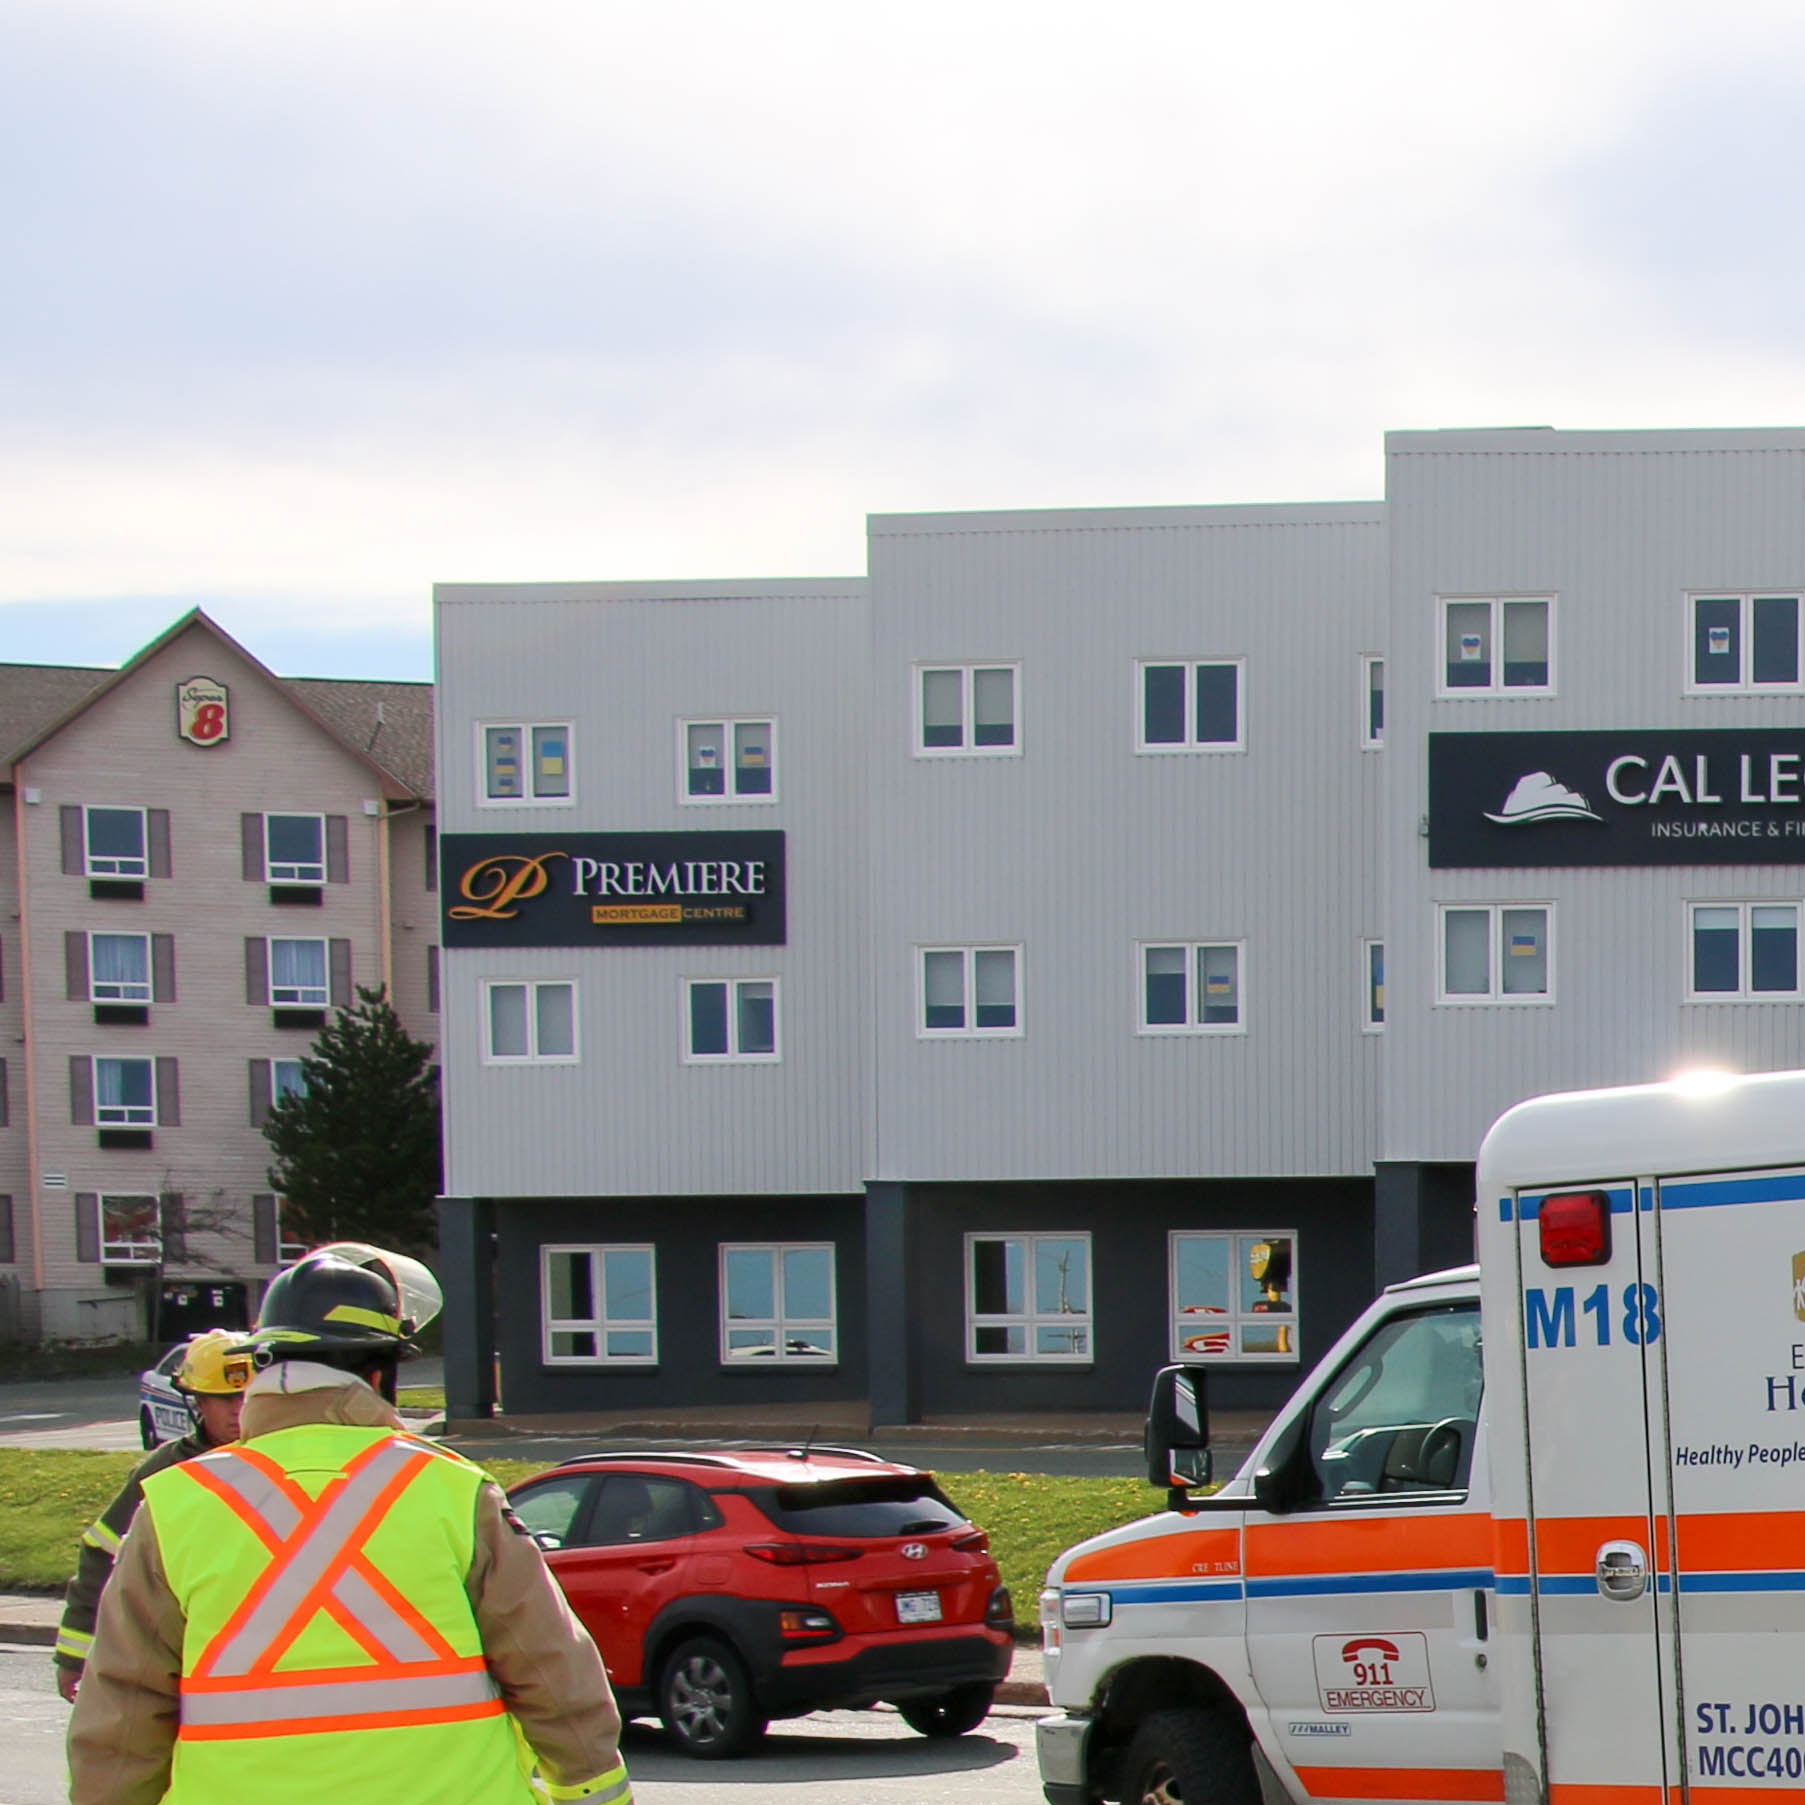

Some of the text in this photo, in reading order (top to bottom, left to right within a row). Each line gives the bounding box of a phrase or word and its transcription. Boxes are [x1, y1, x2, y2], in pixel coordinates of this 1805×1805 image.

[192, 704, 225, 740] 8
[1605, 755, 1723, 804] CAL
[1651, 822, 1762, 838] INSURANCE
[1767, 822, 1780, 837] &
[572, 857, 766, 895] PREMIERE
[595, 906, 745, 920] MORTGAGE CENTRE
[1525, 1283, 1662, 1348] M18
[155, 1406, 187, 1431] POLICE
[1675, 1444, 1744, 1469] Healthy
[1353, 1663, 1394, 1685] 911
[1326, 1690, 1425, 1708] EMERGENCY
[1696, 1703, 1736, 1734] ST.
